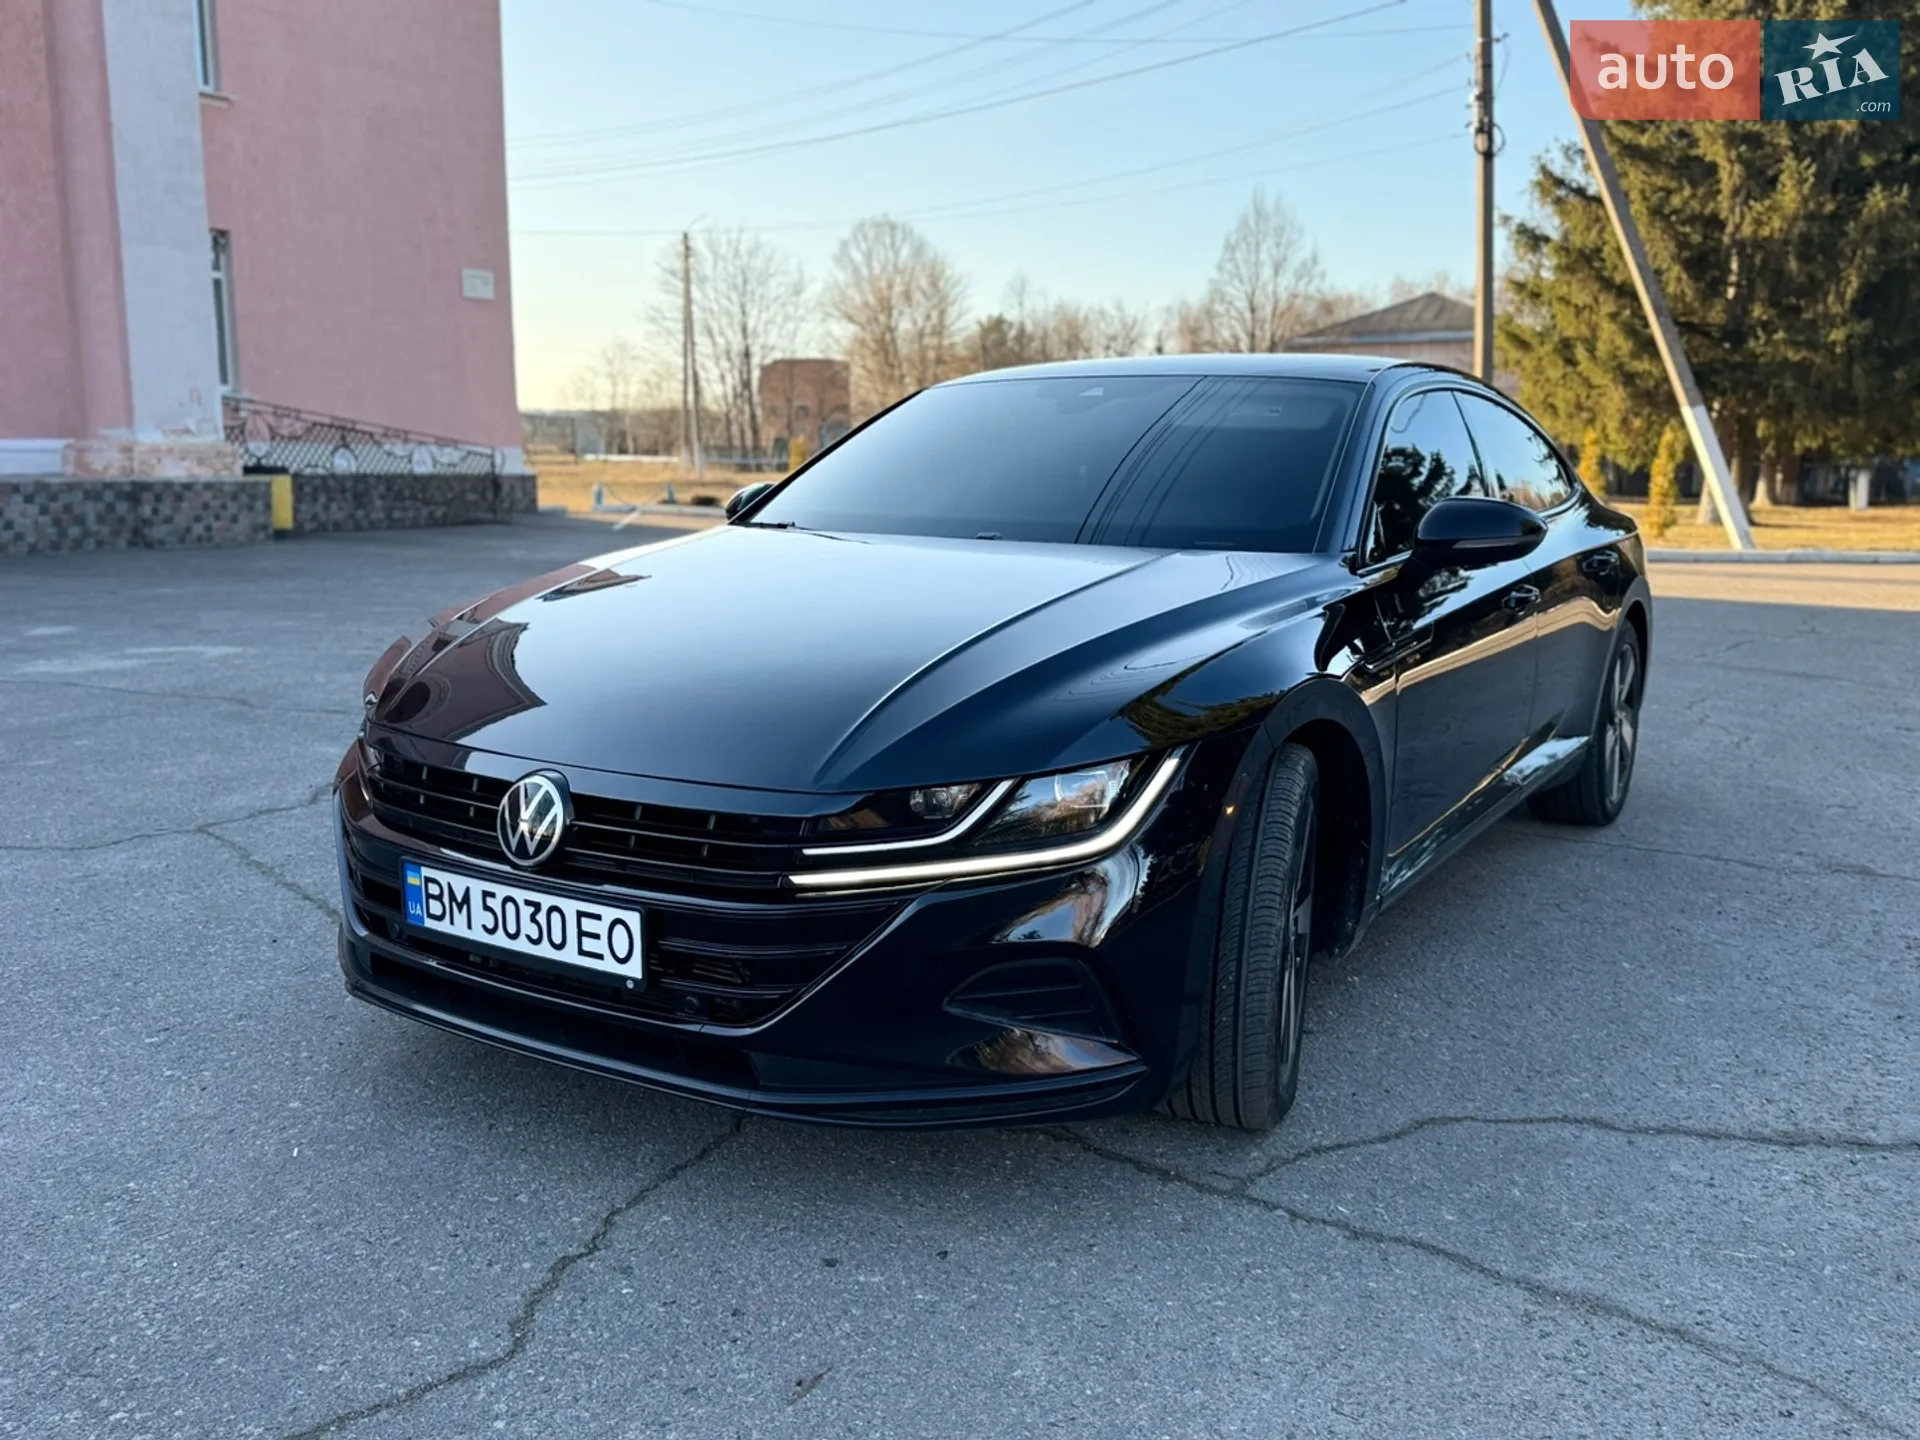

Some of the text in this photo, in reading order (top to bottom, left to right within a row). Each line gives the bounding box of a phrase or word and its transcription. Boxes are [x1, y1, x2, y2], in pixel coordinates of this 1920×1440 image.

[408, 902, 423, 917] UA
[423, 875, 634, 965] BM 5030 EO
